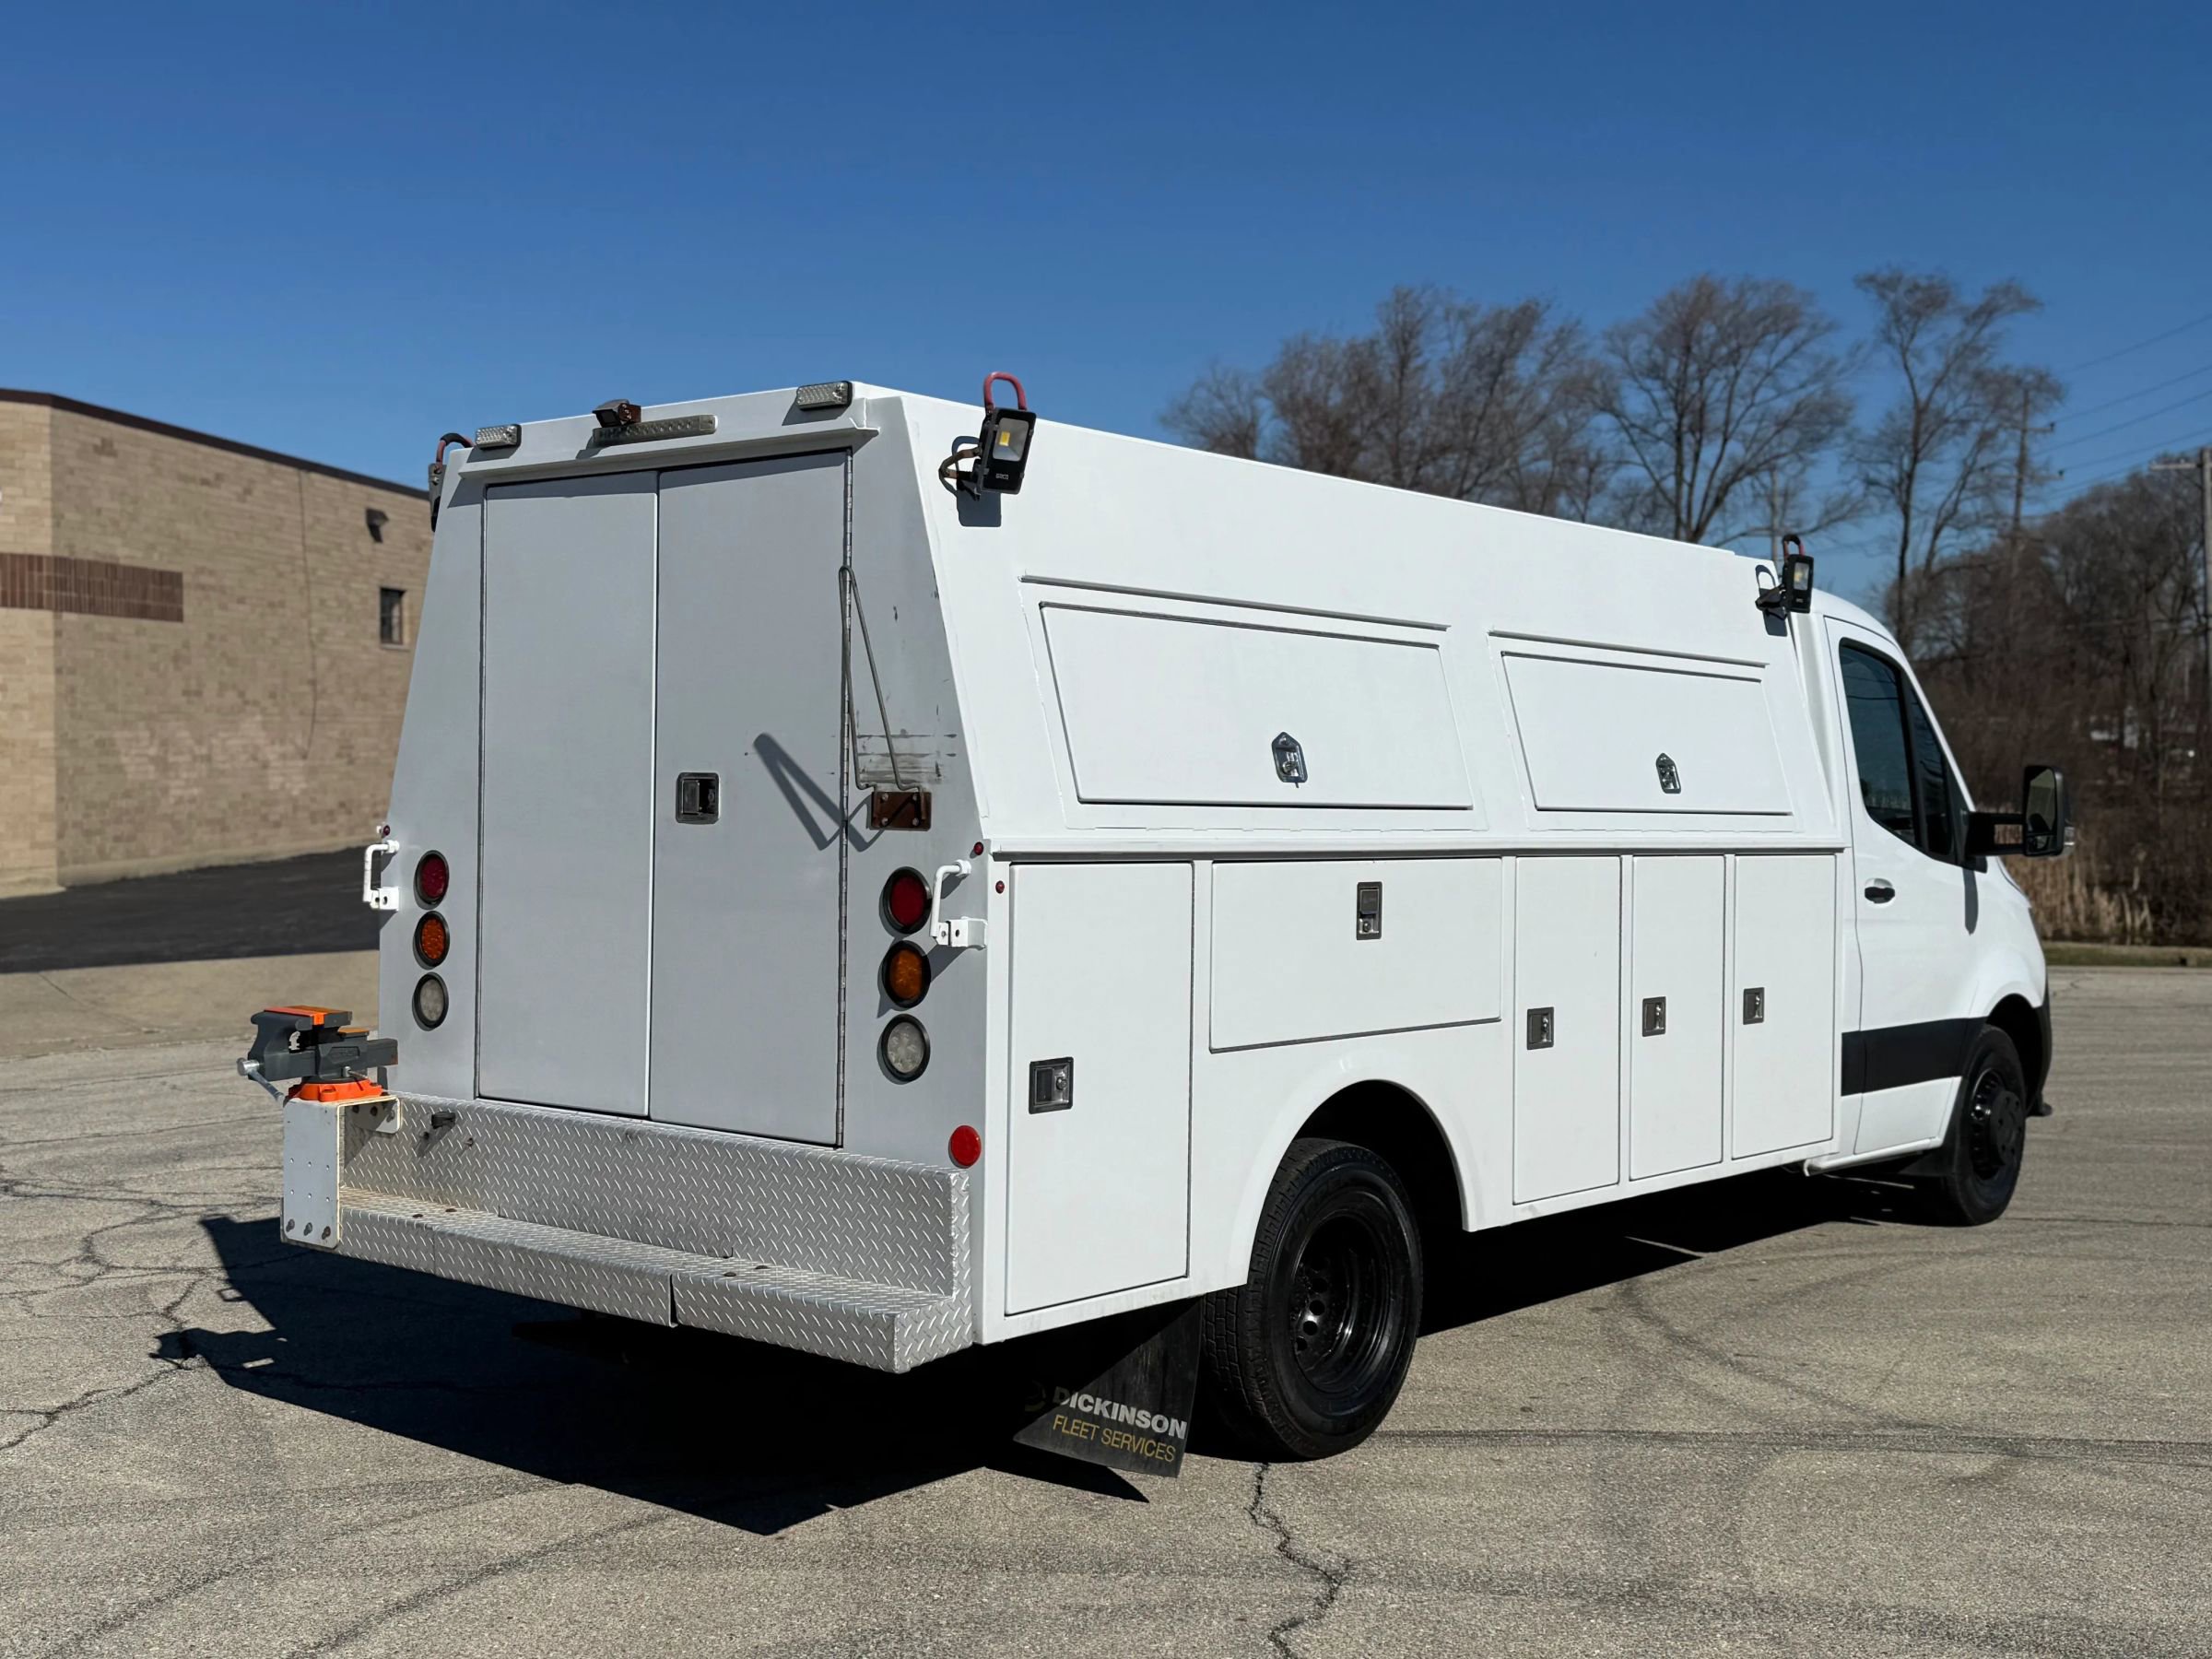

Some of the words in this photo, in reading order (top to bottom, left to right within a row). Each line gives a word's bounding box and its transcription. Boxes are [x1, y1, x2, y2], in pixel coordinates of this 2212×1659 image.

[1053, 1386, 1187, 1439] DICKINSON
[1053, 1415, 1100, 1441] FLEET
[1101, 1428, 1176, 1462] SERVICES
